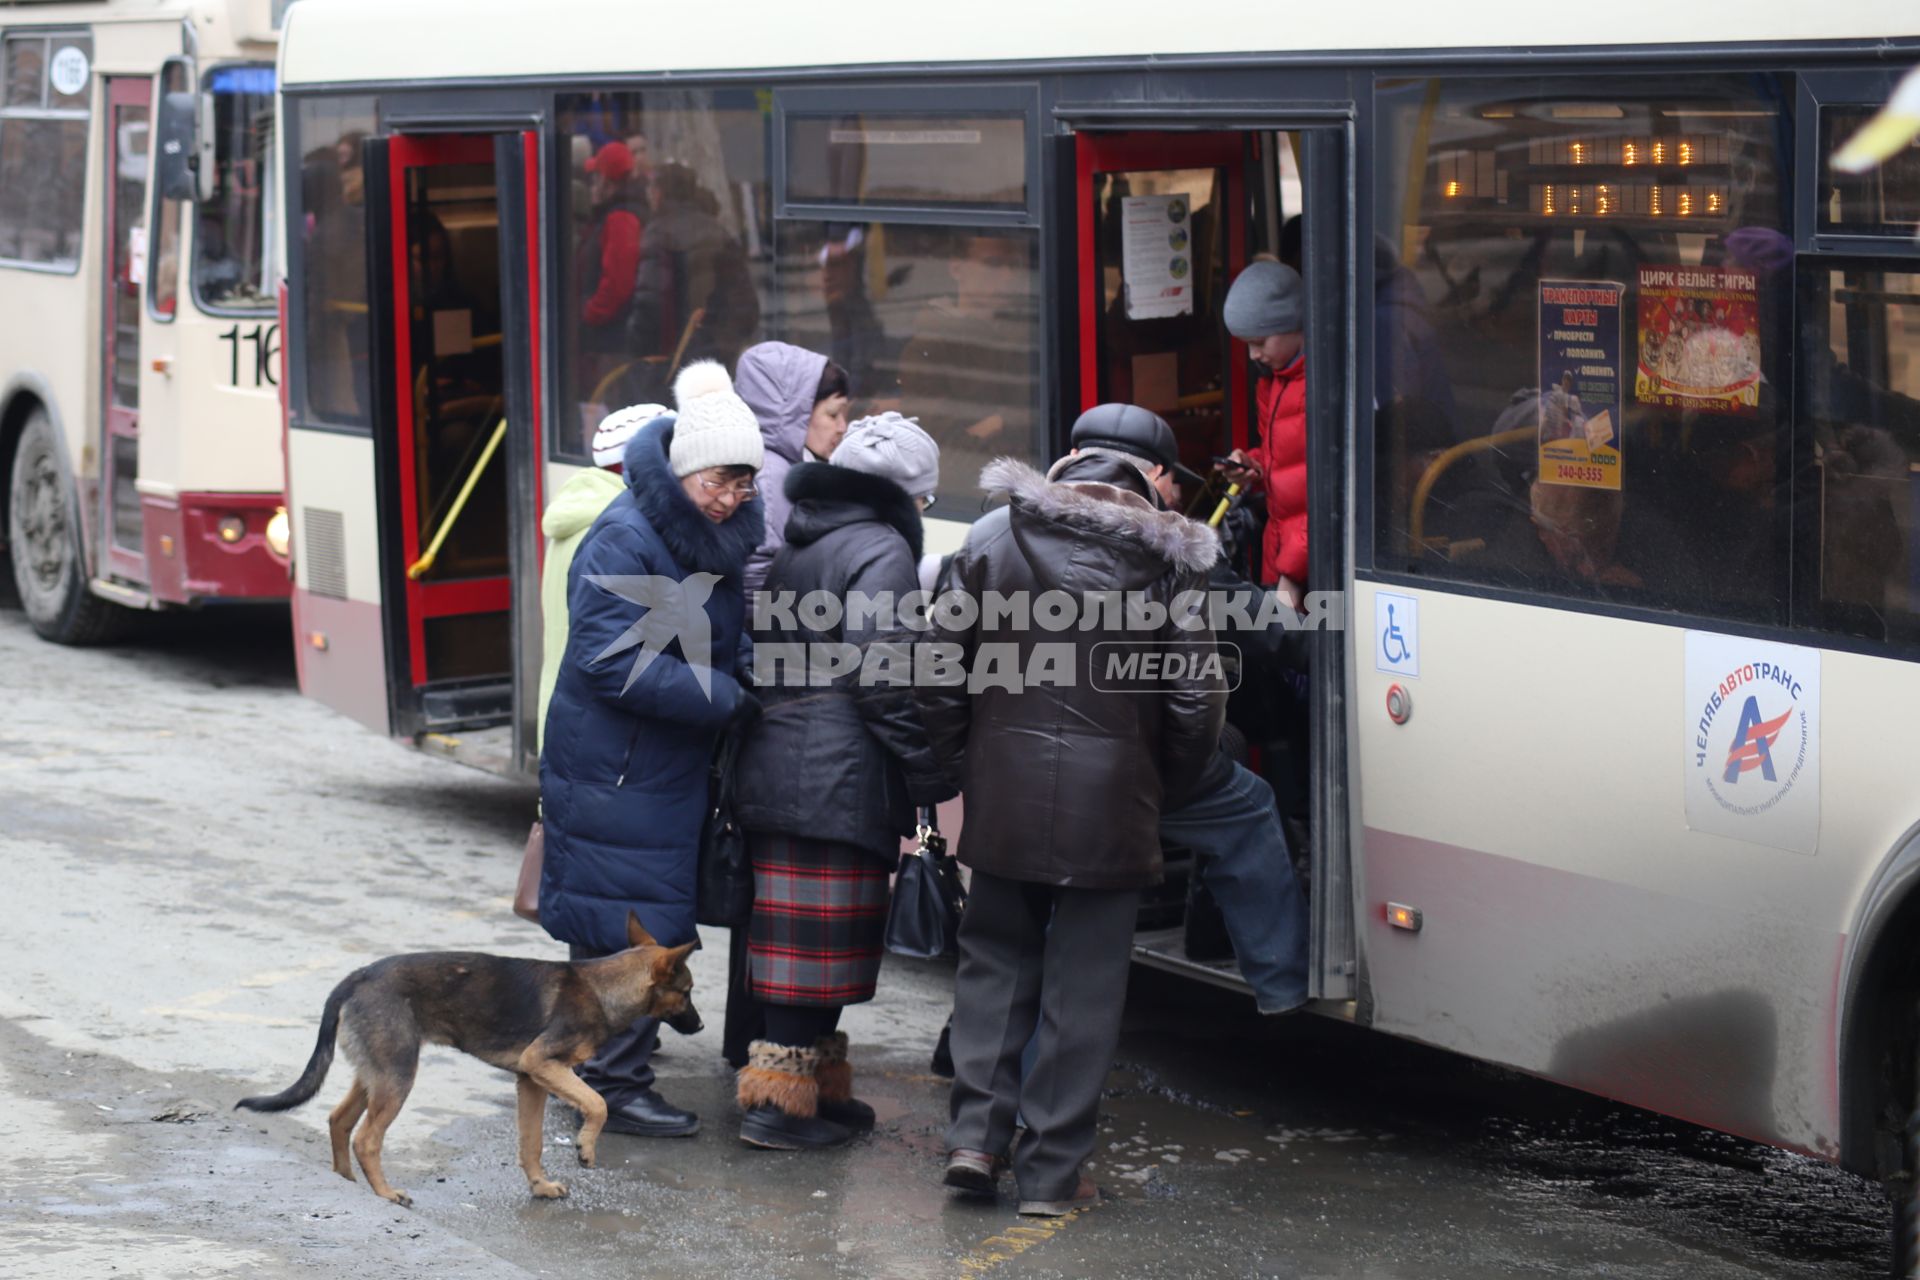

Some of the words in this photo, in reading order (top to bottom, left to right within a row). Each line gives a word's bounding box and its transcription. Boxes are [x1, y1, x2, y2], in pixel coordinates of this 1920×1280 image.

[1640, 270, 1674, 287] ЦИРК
[1677, 272, 1716, 288] БЕЛЫЕ
[1543, 288, 1618, 306] ТРАНСПОРТНЫЕ
[1563, 308, 1598, 326] КАРТЫ
[1553, 330, 1594, 342] ПРИОБРЕСТИ
[1566, 348, 1605, 359] ПОПОЛНИТЬ
[1558, 465, 1603, 481] 240-0-555
[1696, 662, 1803, 768] ЧЕЛЯБАВТОТРАНС
[1759, 780, 1794, 814] УНИТАРНОЕ
[1790, 711, 1808, 782] ПРЕДПРИЯТИЕ
